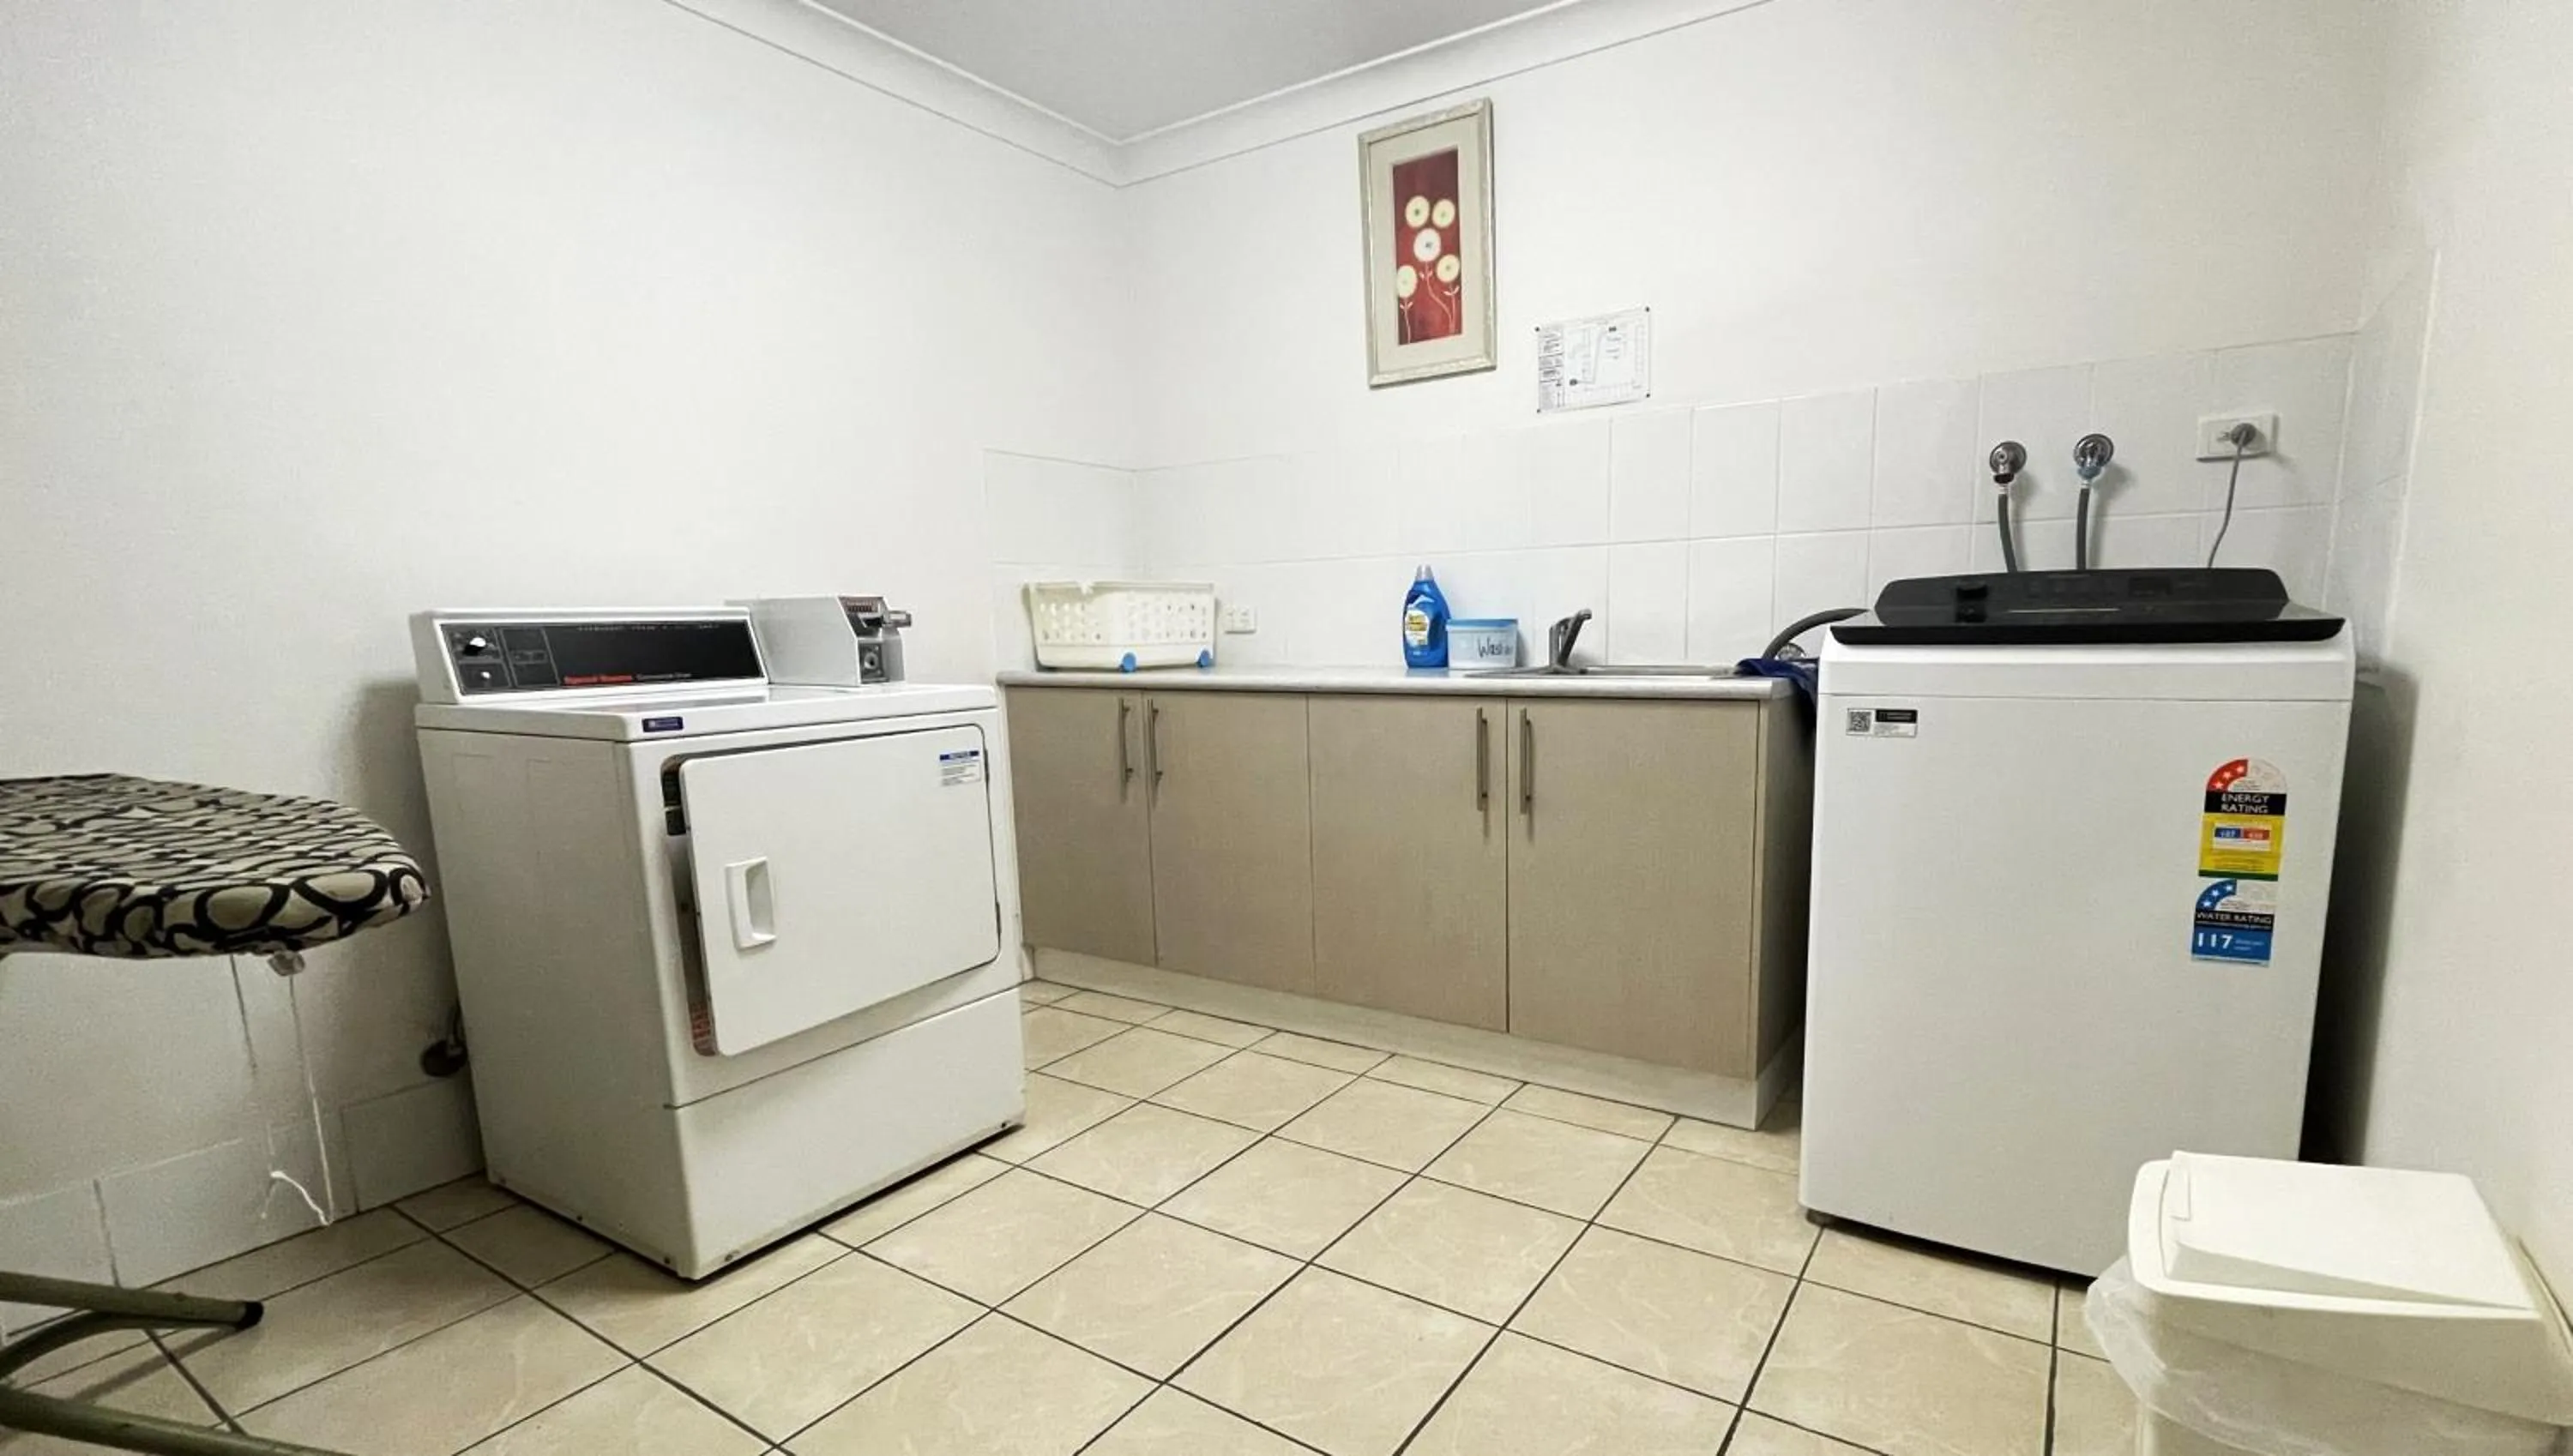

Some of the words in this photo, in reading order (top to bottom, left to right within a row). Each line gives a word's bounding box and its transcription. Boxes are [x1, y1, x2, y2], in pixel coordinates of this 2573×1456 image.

[2221, 793, 2269, 803] ENERGY
[2220, 803, 2269, 814] RATING
[2196, 912, 2231, 920] WATER
[2233, 914, 2272, 924] RATING
[2198, 933, 2233, 949] 117
